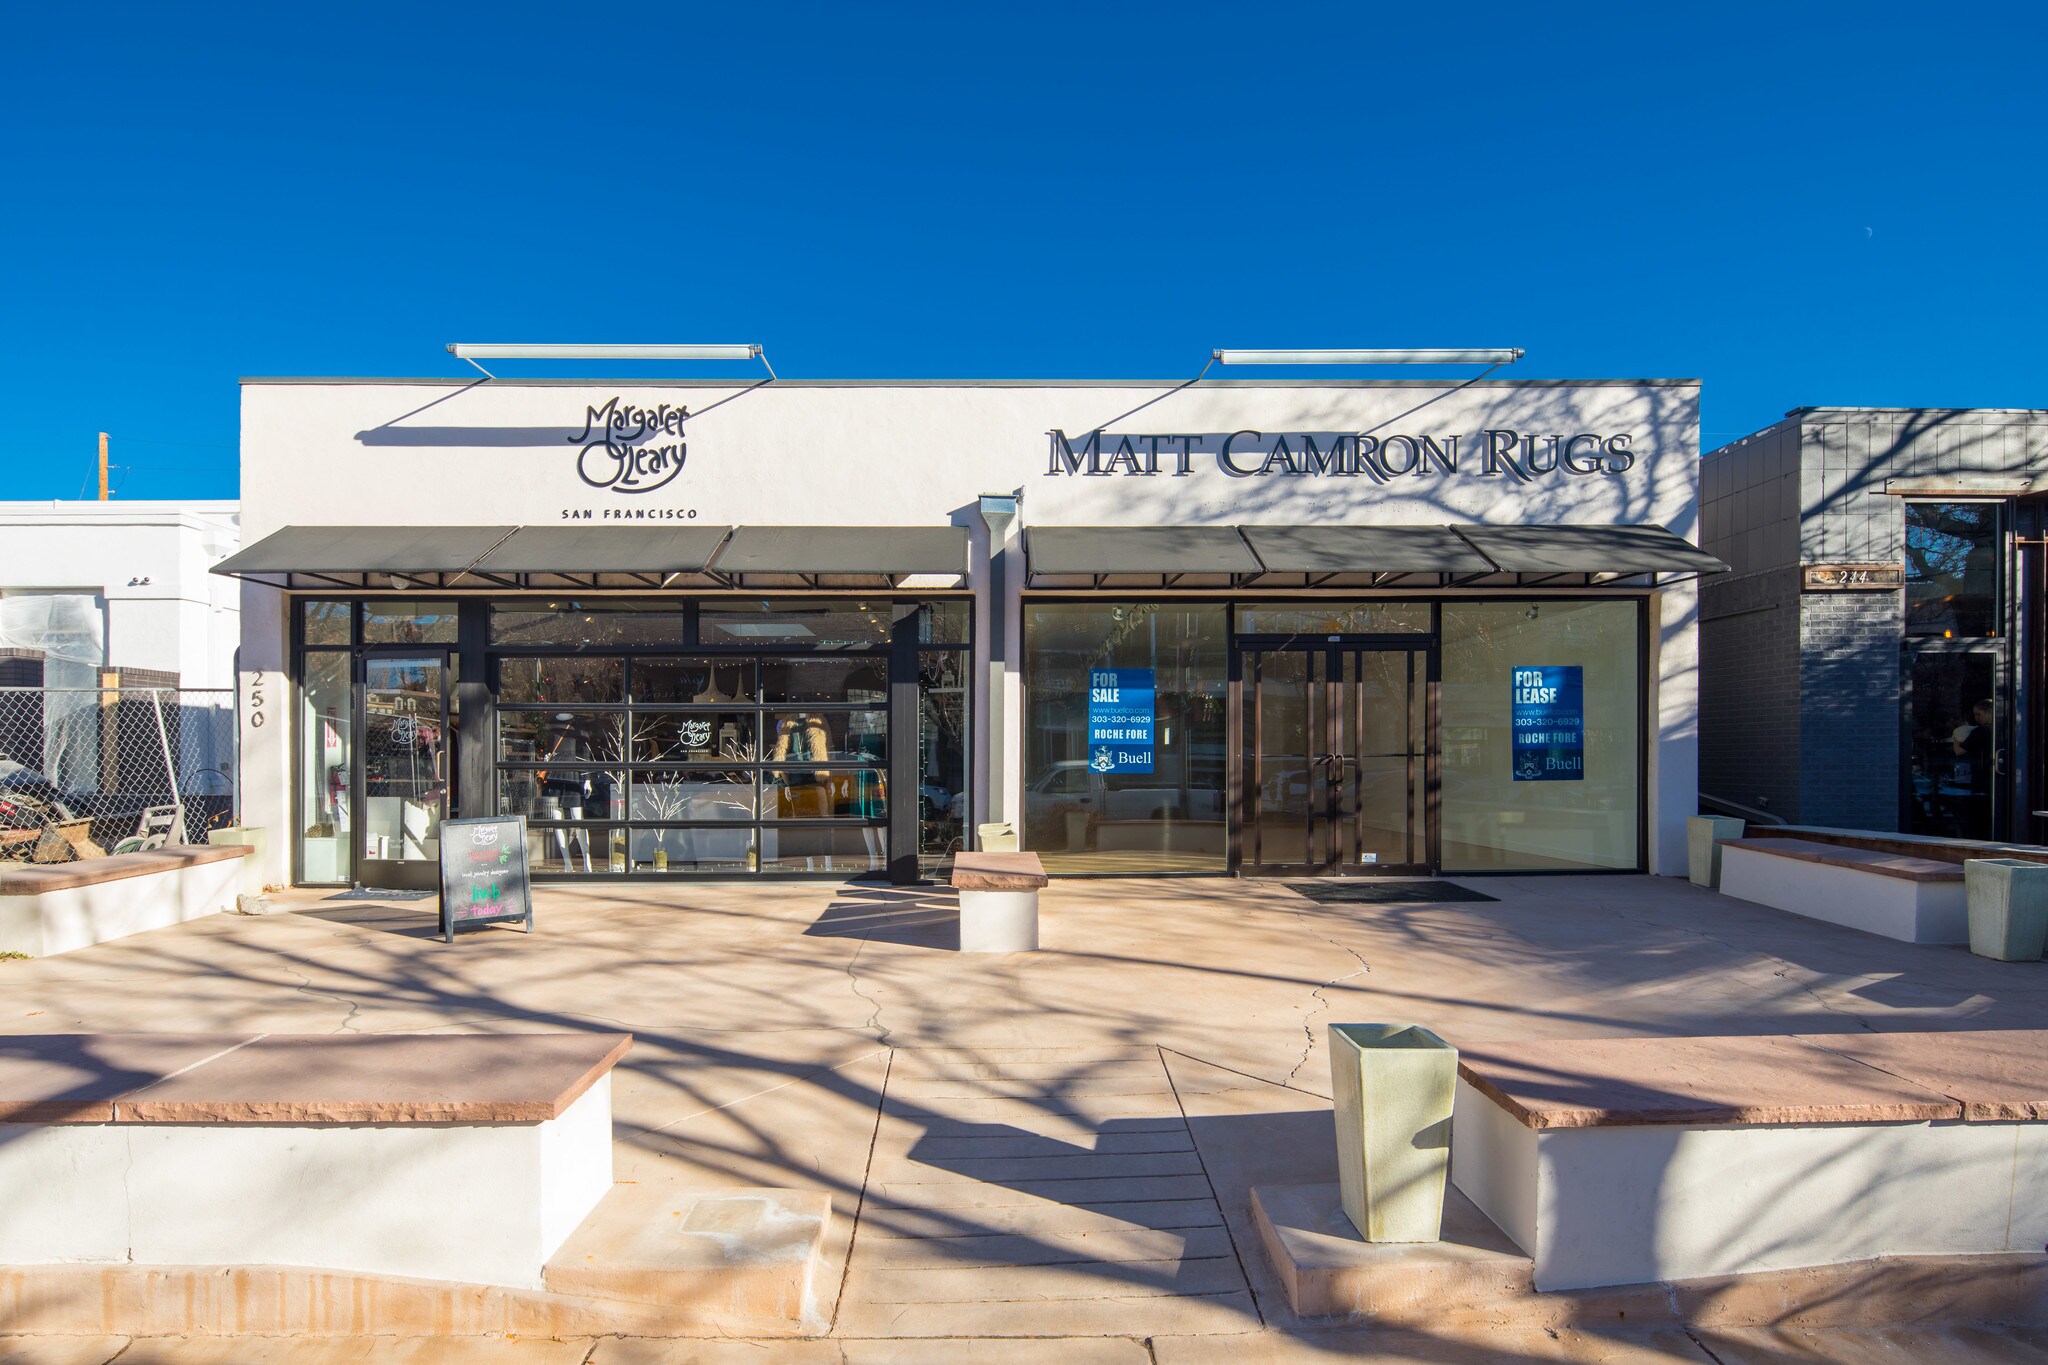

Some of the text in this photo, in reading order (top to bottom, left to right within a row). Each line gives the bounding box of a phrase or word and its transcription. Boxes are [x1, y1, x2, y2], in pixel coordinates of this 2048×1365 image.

[567, 397, 690, 443] Margaret
[1049, 428, 1636, 485] MATT CAMRON RUGS
[562, 509, 697, 519] SAN FRANCISCO
[1839, 570, 1868, 584] 244
[1092, 672, 1118, 687] FOR
[1515, 671, 1543, 687] FOR
[251, 668, 265, 728] 250
[1092, 688, 1120, 703] SALE
[1515, 687, 1557, 704] LEASE
[1093, 706, 1150, 714] www.buellco.com
[1091, 715, 1151, 723] 303-320-6929
[1515, 717, 1580, 726] 303-320-6929
[1094, 729, 1148, 739] ROCHE FORE
[1518, 732, 1577, 744] ROCHE FORE
[1118, 752, 1151, 764] Buell
[1546, 757, 1582, 770] Buell
[470, 902, 503, 917] today
